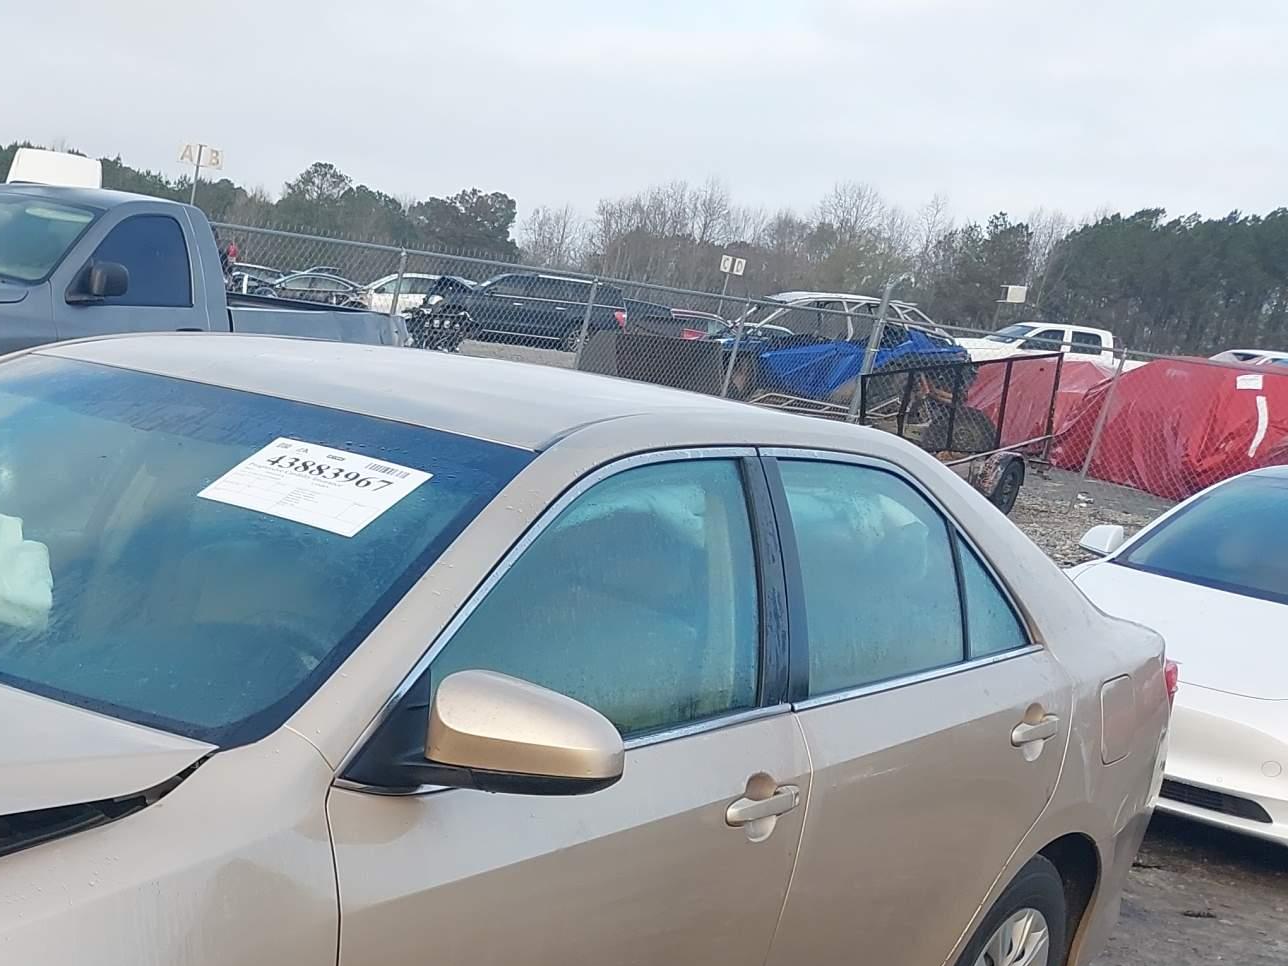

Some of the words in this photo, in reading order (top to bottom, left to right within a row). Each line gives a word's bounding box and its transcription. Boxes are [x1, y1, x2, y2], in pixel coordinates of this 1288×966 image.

[180, 143, 193, 162] A
[210, 148, 220, 166] B
[266, 454, 394, 492] 43883967
